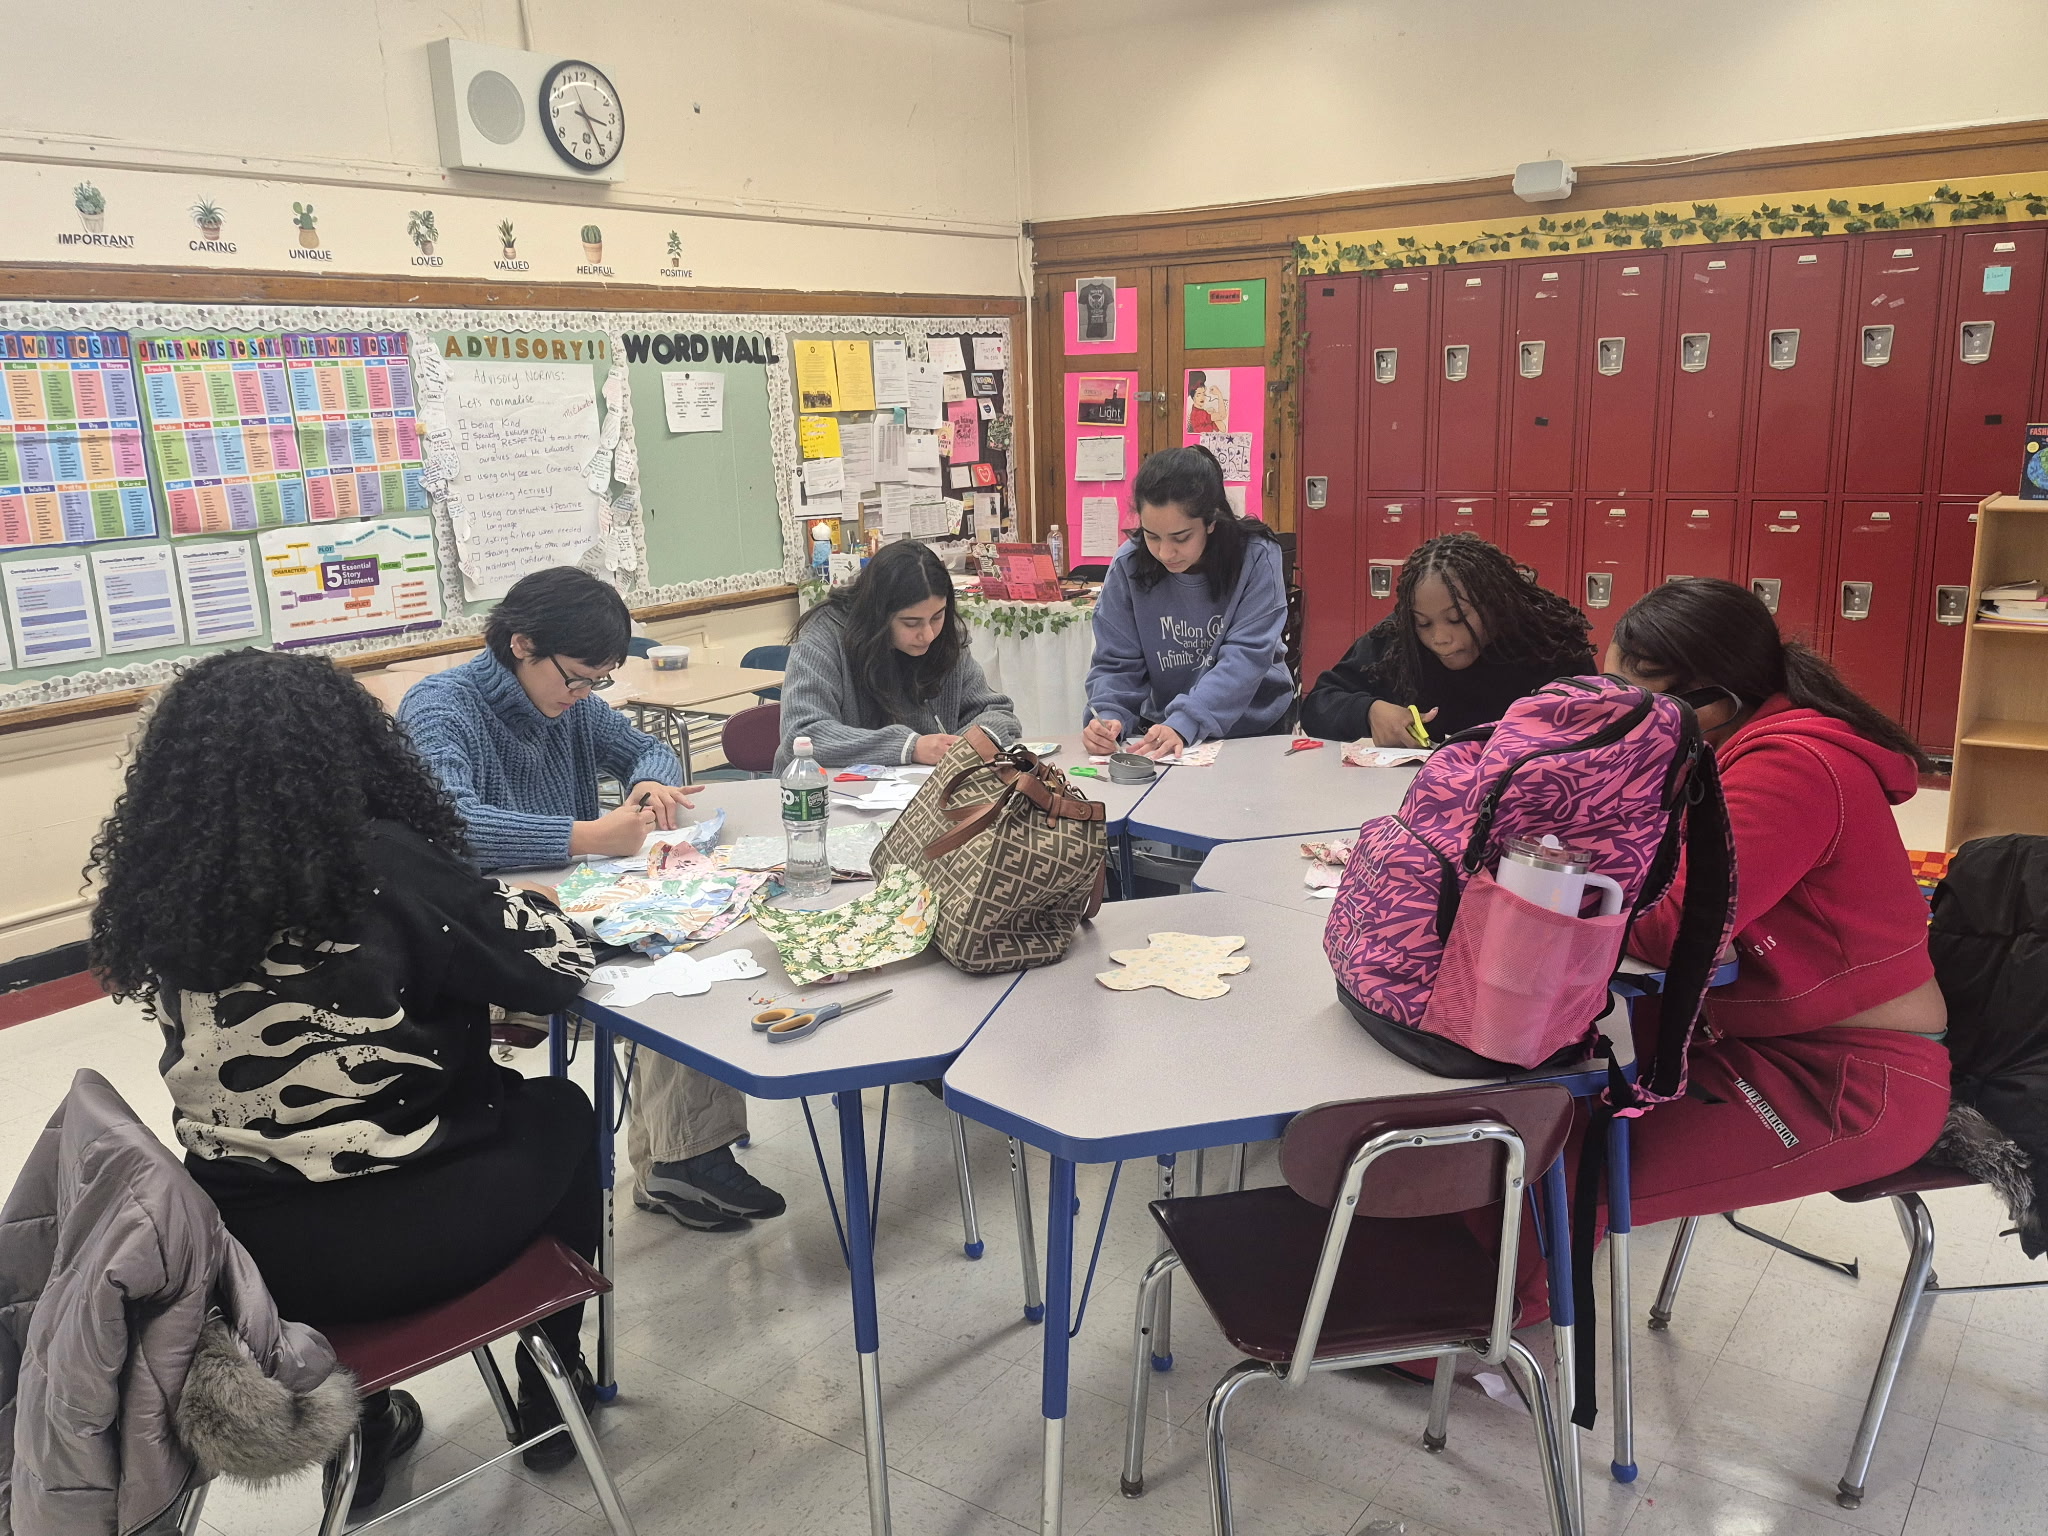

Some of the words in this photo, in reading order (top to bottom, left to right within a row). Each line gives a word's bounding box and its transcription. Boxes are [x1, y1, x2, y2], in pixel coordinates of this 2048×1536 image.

[552, 106, 559, 118] 9
[609, 113, 615, 124] 3
[559, 127, 565, 138] 8
[606, 130, 612, 141] 4
[571, 142, 578, 154] 7
[585, 148, 592, 160] 6
[58, 233, 135, 247] IMPORTANT
[188, 240, 237, 253] CARING
[289, 248, 332, 260] UNIQUE
[411, 256, 444, 266] LOVED
[494, 260, 530, 270] VALUED
[660, 268, 692, 278] POSITIVE
[22, 338, 64, 354] WAYS
[68, 338, 87, 354] TO
[140, 342, 185, 358] OTHER
[188, 342, 225, 357] WAYS
[229, 340, 246, 356] TO
[284, 339, 324, 354] OTHER
[328, 338, 359, 353] WAYS
[363, 338, 378, 352] TO
[445, 336, 604, 360] ADVISORY!!
[622, 334, 708, 364] WORD
[711, 335, 780, 364] WALL
[474, 369, 518, 389] Advisory
[526, 370, 565, 382] NORMS:
[489, 395, 535, 407] normalise
[1099, 406, 1120, 420] Light
[471, 422, 494, 434] being
[476, 442, 496, 453] being
[326, 565, 342, 588] 5
[341, 562, 371, 570] Essential
[343, 577, 374, 585] Elements
[1160, 616, 1203, 642] Mellon
[1183, 639, 1197, 648] and
[1200, 639, 1213, 648] the
[1157, 650, 1194, 671] Infinite
[1734, 1077, 1762, 1103] TRUE
[1757, 1101, 1798, 1148] RELIGION
